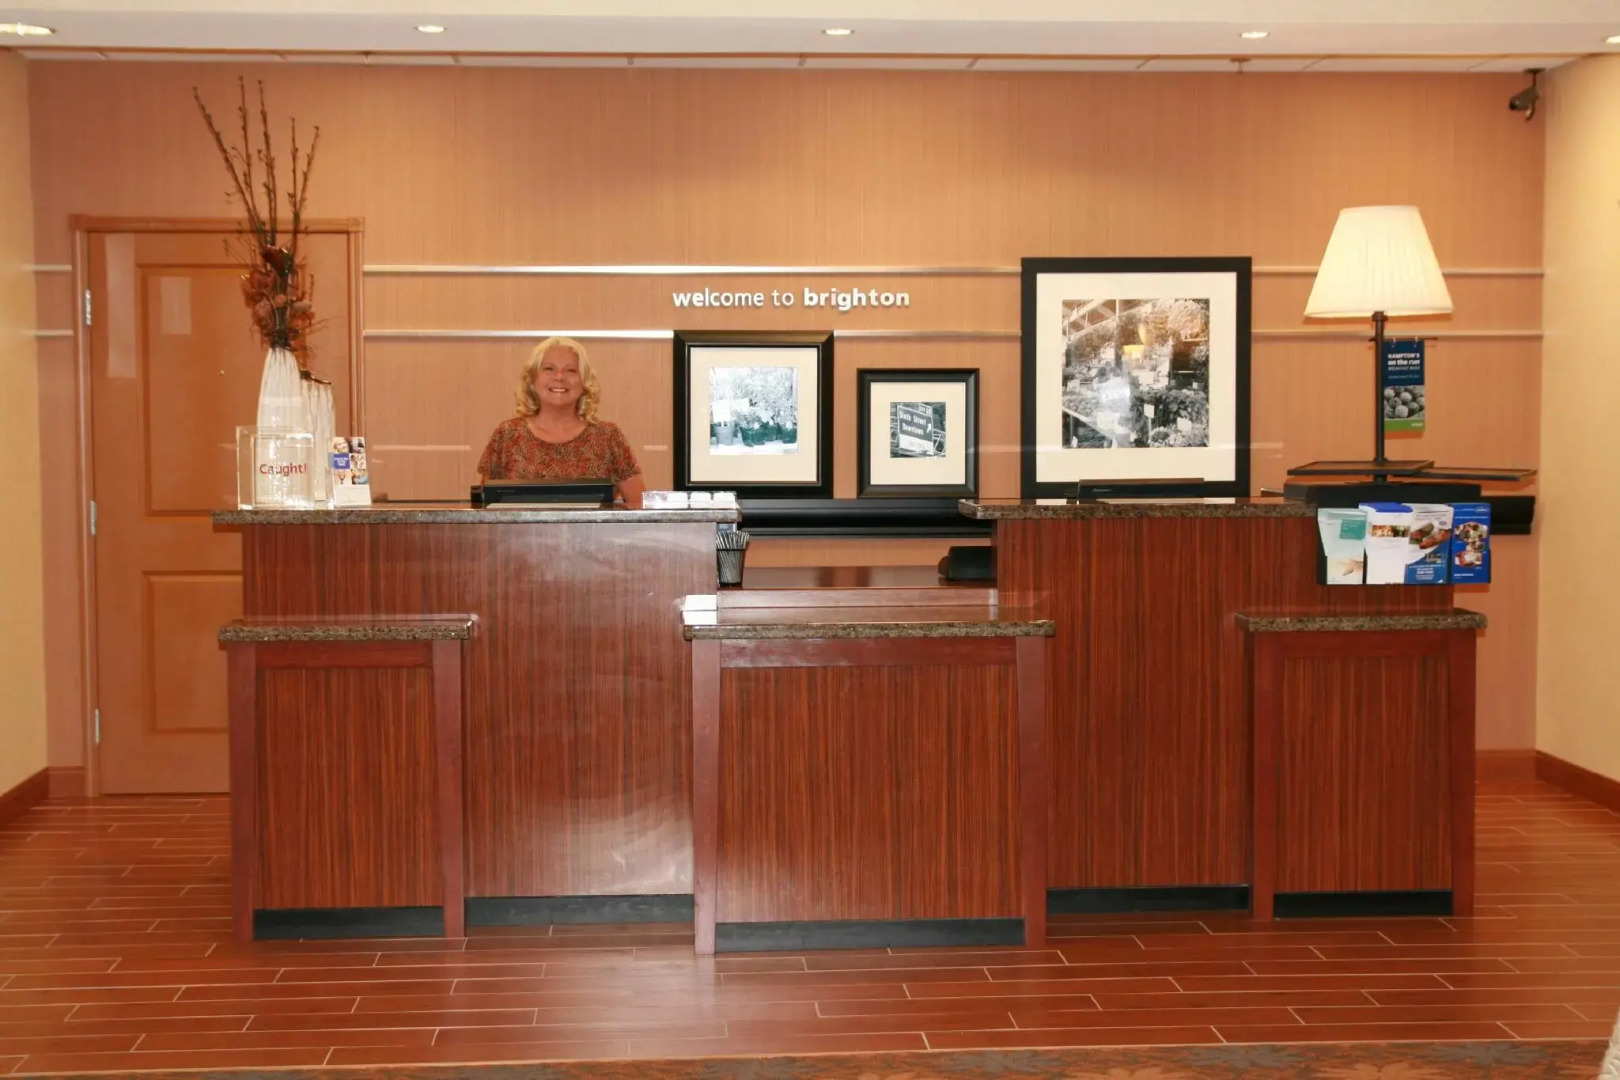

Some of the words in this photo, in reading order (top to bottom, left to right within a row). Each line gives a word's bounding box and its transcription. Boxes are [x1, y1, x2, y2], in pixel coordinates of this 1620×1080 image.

[672, 288, 765, 307] welcome
[772, 289, 795, 307] to
[803, 288, 910, 311] brighton
[913, 415, 926, 425] Street
[902, 423, 923, 435] Downtown
[259, 463, 307, 476] Caught!
